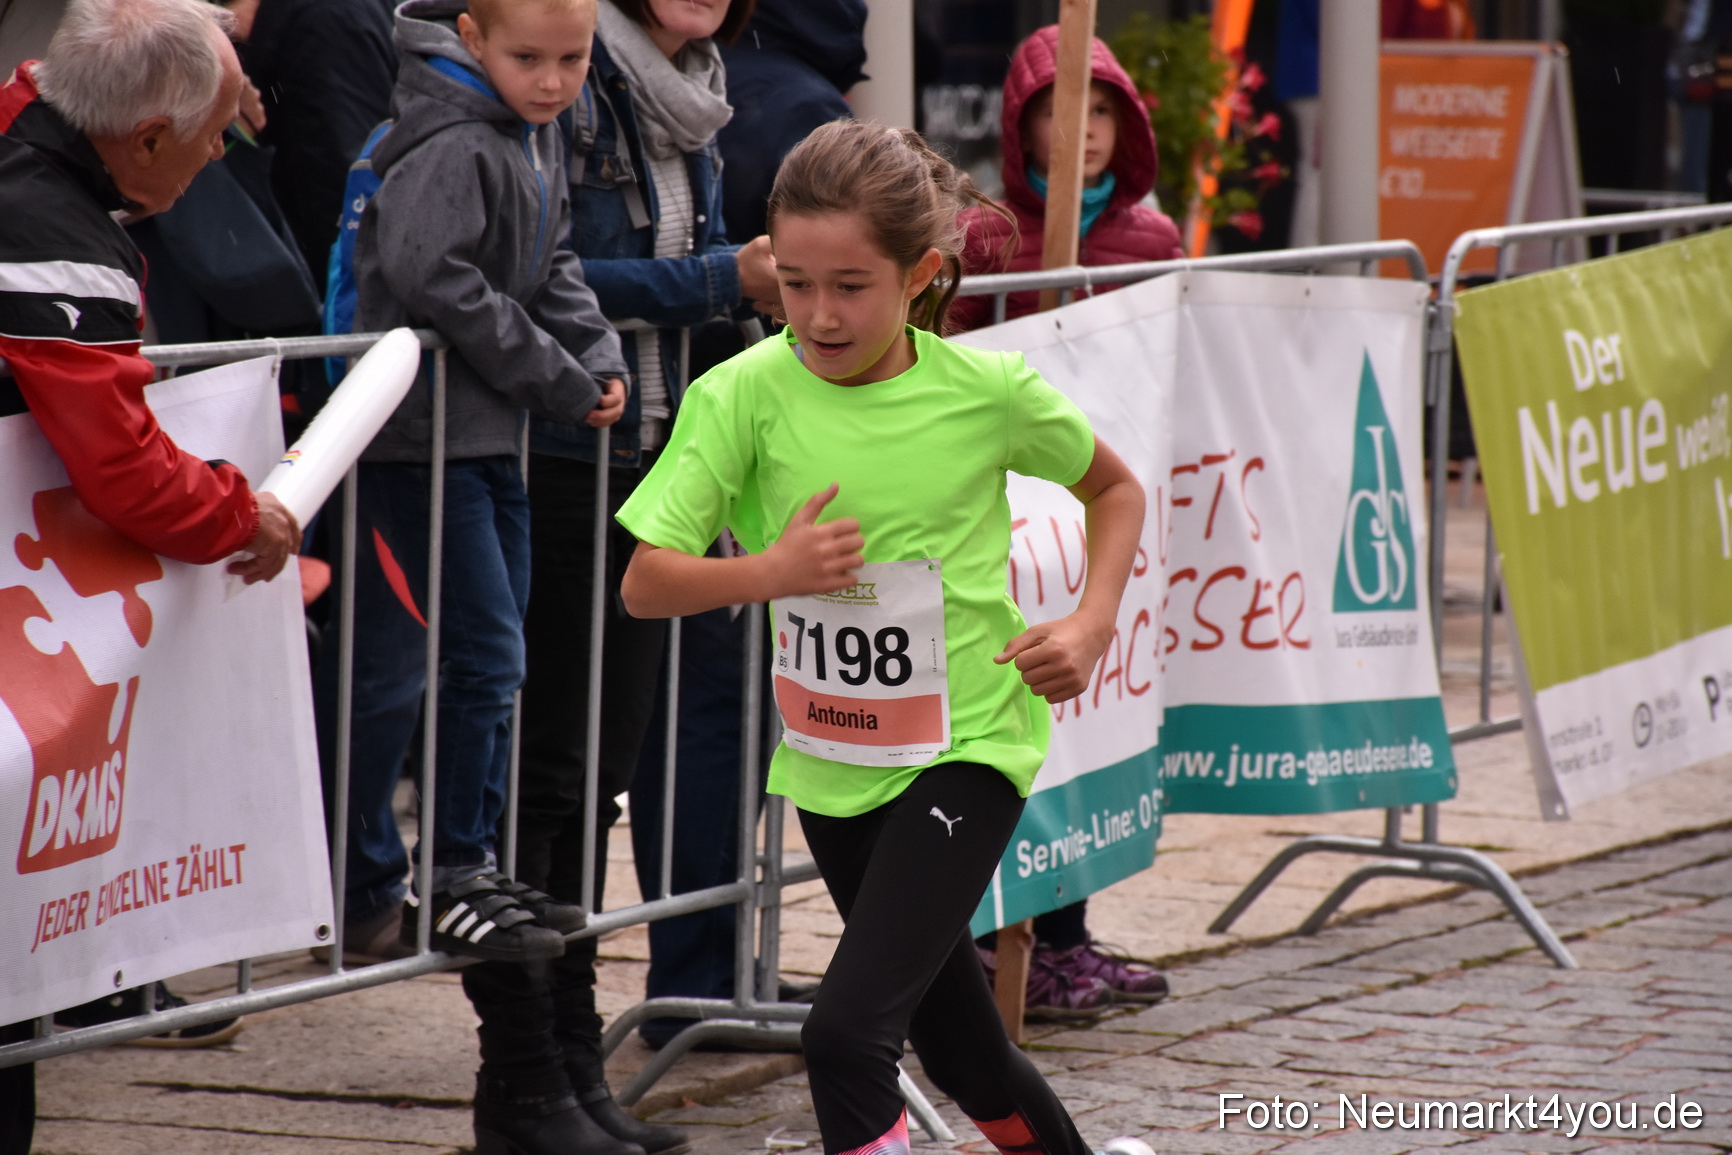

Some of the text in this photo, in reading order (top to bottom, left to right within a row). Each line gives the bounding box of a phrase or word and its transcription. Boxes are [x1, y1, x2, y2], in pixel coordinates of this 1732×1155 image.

[1394, 84, 1509, 118] MODERNE
[1563, 328, 1625, 392] Der
[1518, 397, 1669, 516] Neue
[788, 610, 913, 687] 7198
[807, 700, 878, 731] Antonia
[26, 750, 122, 859] DKMS
[31, 843, 247, 954] JEDER EINZELNE ZÄHLT
